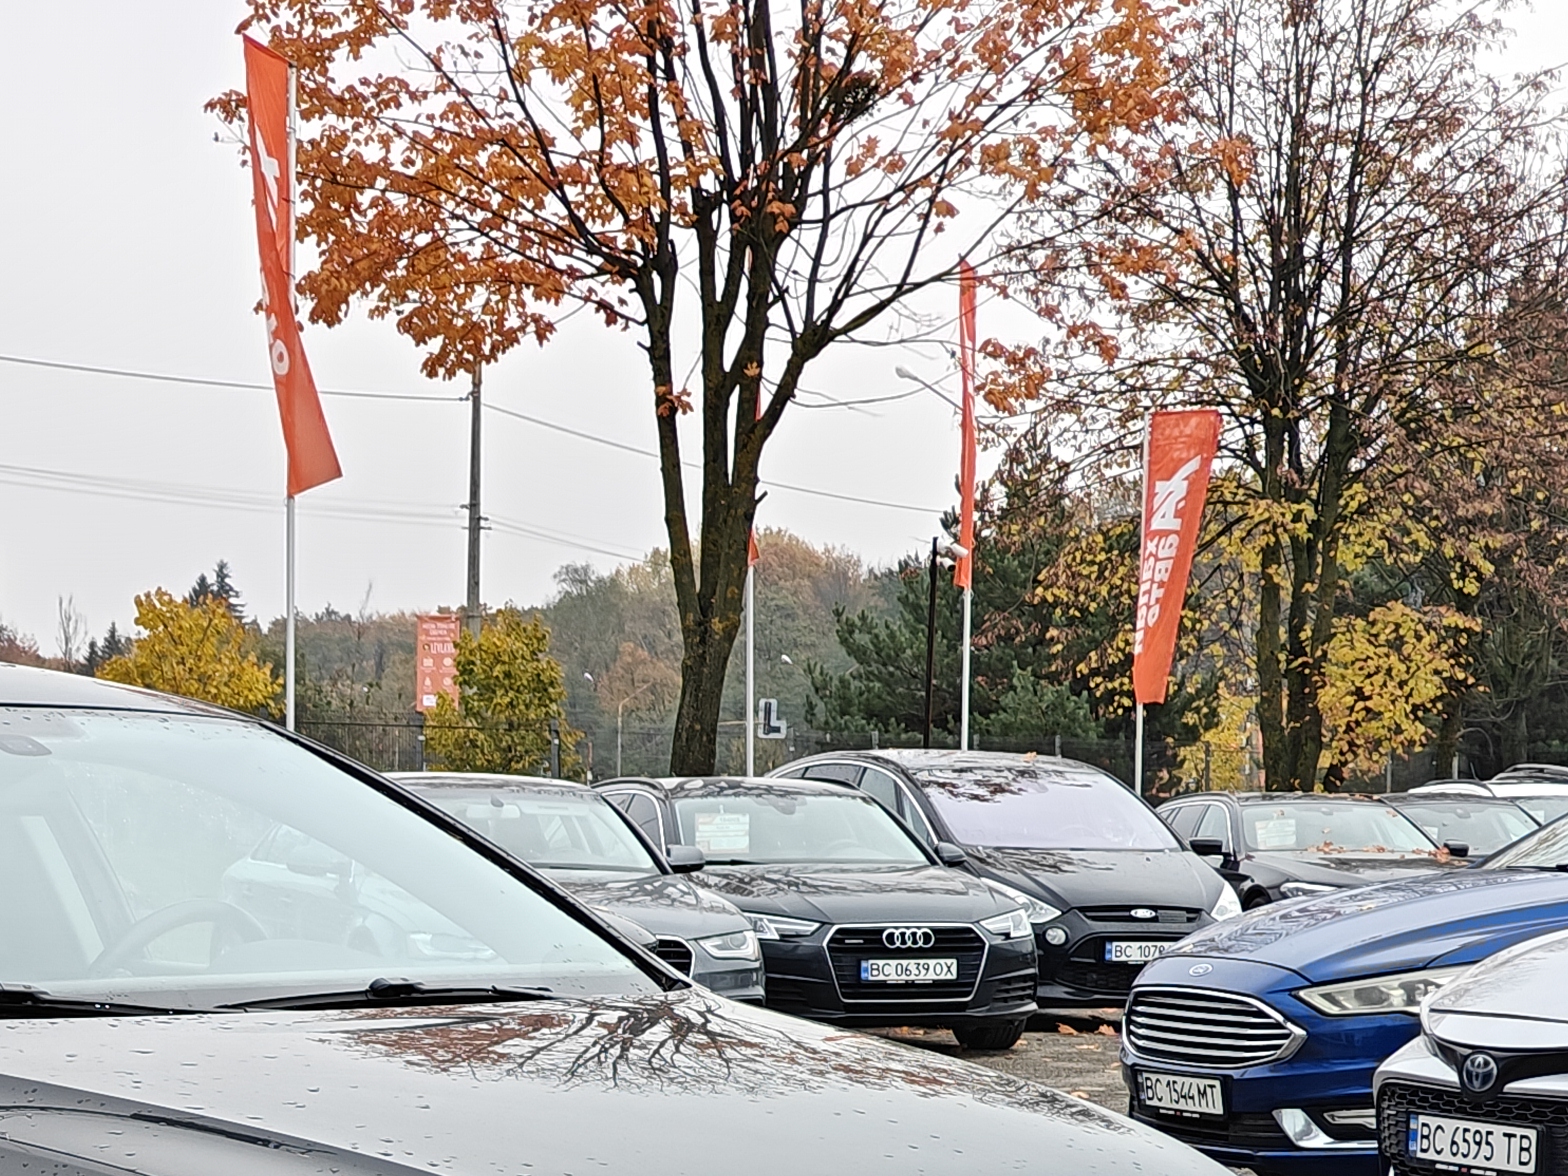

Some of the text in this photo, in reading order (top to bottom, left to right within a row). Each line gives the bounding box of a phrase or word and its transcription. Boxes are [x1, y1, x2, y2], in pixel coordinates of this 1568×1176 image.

[1114, 944, 1133, 958] BC
[870, 962, 954, 977] BC 0639 OX
[1144, 1076, 1217, 1110] BC 1544 MT
[1419, 1122, 1533, 1167] BC 6595 TB
